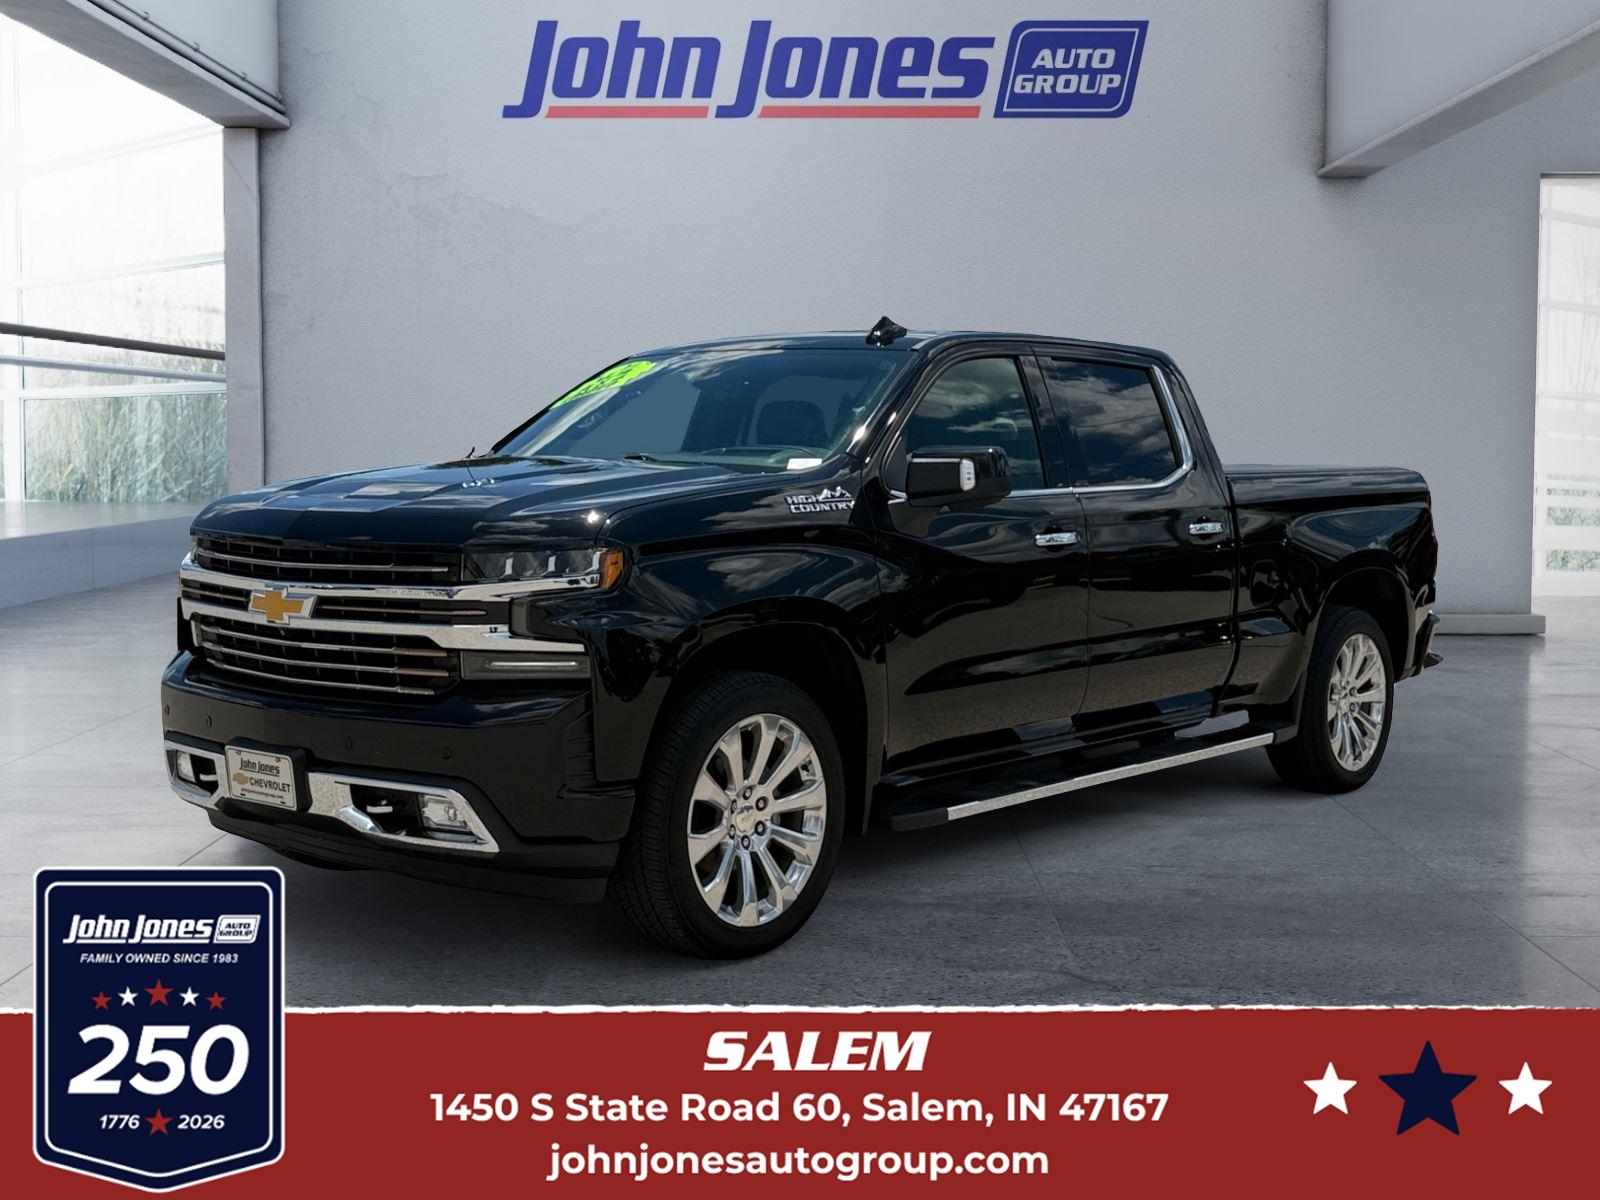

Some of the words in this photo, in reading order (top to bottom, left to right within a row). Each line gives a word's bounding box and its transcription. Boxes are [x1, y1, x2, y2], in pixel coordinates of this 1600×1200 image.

[1031, 47, 1116, 70] AUTO
[502, 19, 721, 119] John
[715, 19, 995, 119] Jones
[1013, 73, 1122, 96] GROUP
[785, 495, 821, 504] HIGH
[789, 501, 855, 514] COUNTRY
[240, 757, 257, 771] John
[257, 761, 280, 775] Jones
[249, 776, 291, 793] CHEVROLET
